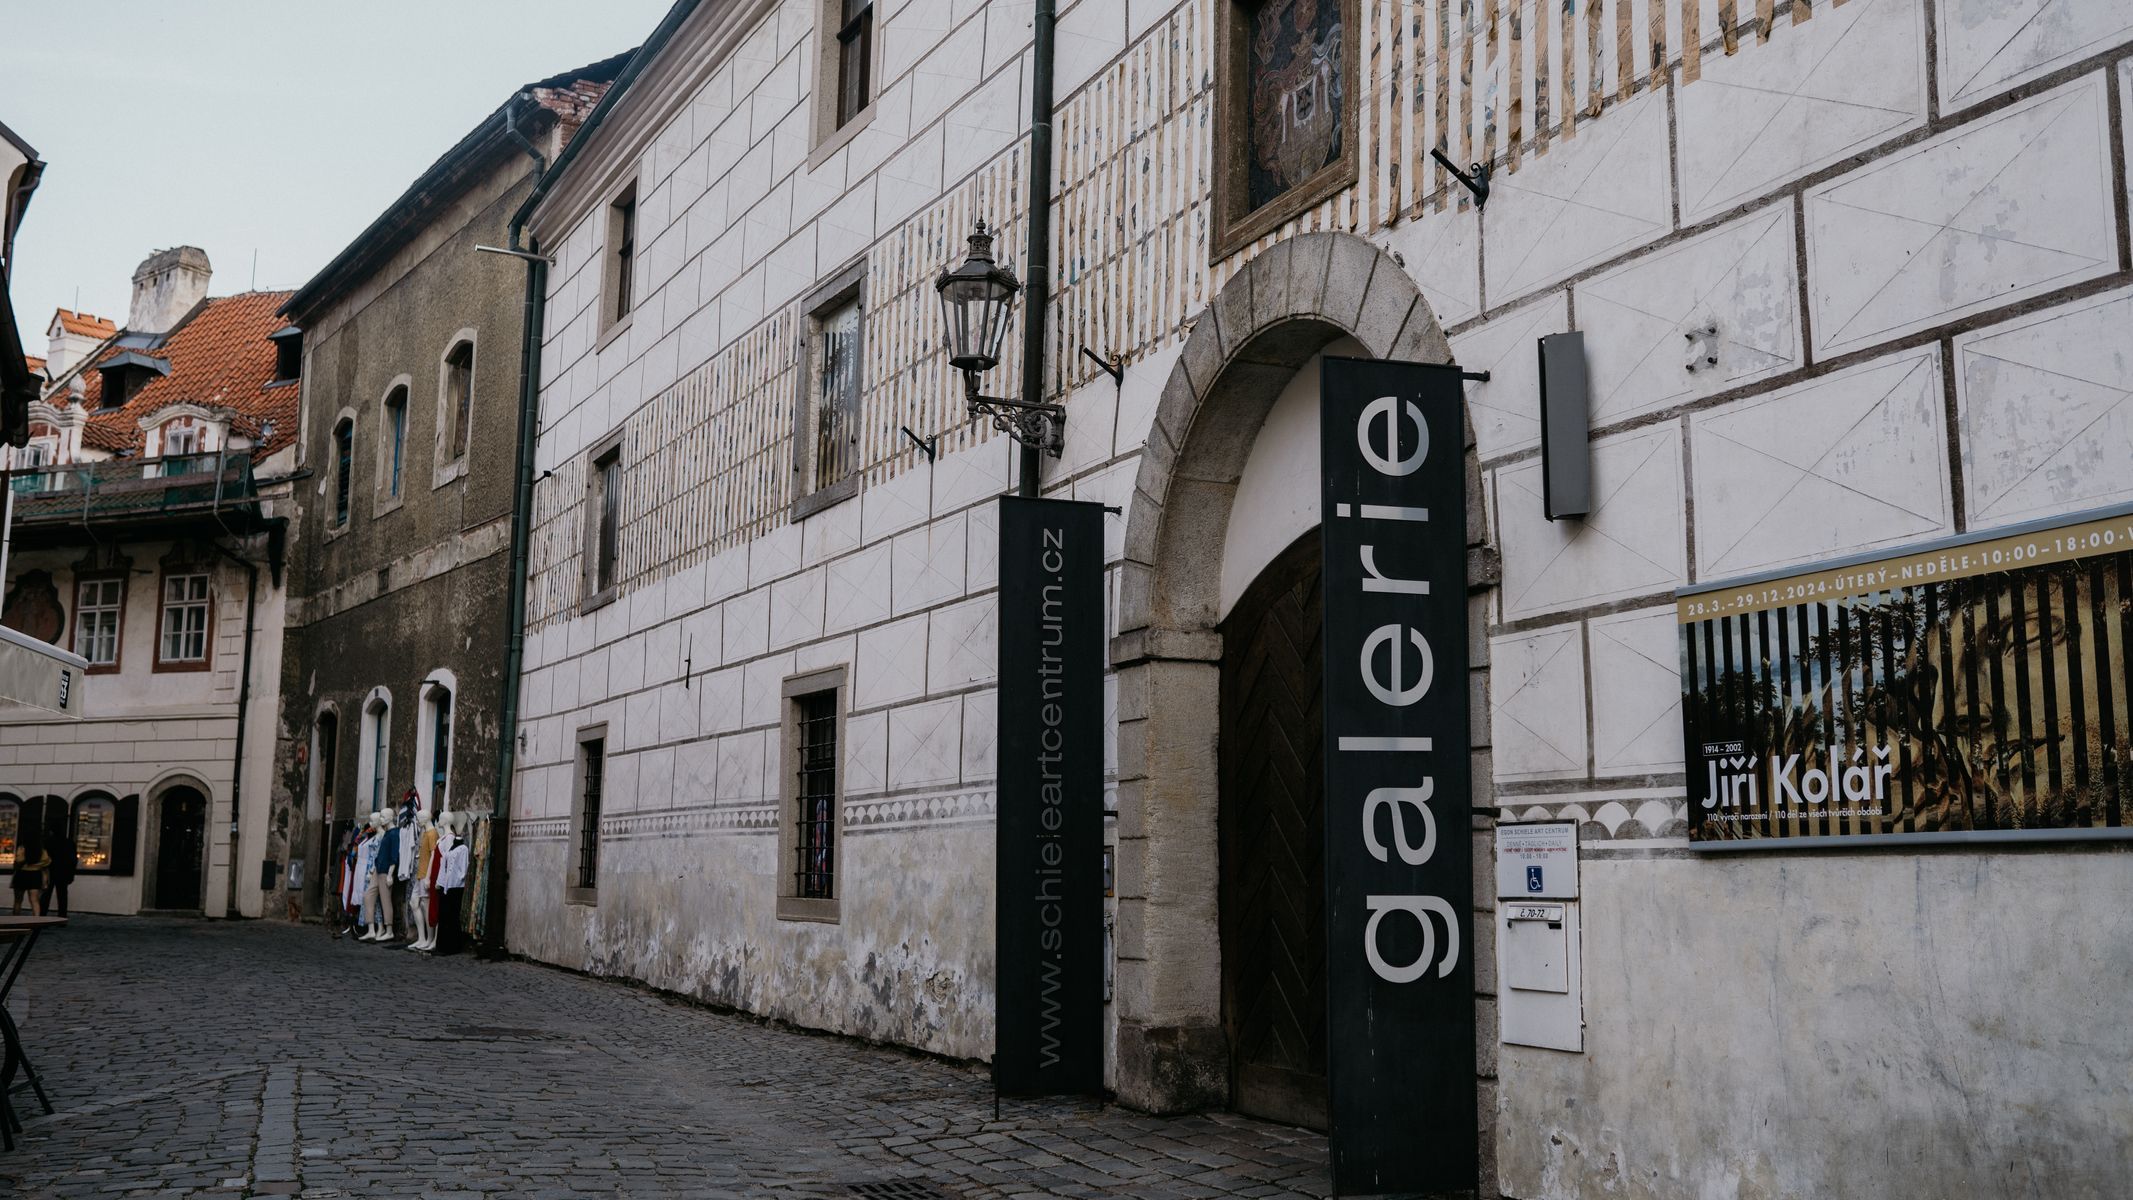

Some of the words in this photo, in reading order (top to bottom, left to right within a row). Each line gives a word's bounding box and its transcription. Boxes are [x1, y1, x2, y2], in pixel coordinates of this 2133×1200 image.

[1336, 396, 1460, 983] galerie
[1704, 745, 1719, 754] 1914
[1725, 743, 1742, 752] 2002
[1701, 755, 1758, 809] Jiří
[1772, 745, 1892, 804] Kolář
[1774, 810, 1786, 819] 110
[1799, 811, 1808, 819] ze
[1808, 808, 1827, 818] všech
[1857, 806, 1883, 816] období
[1526, 909, 1545, 918] 70-72
